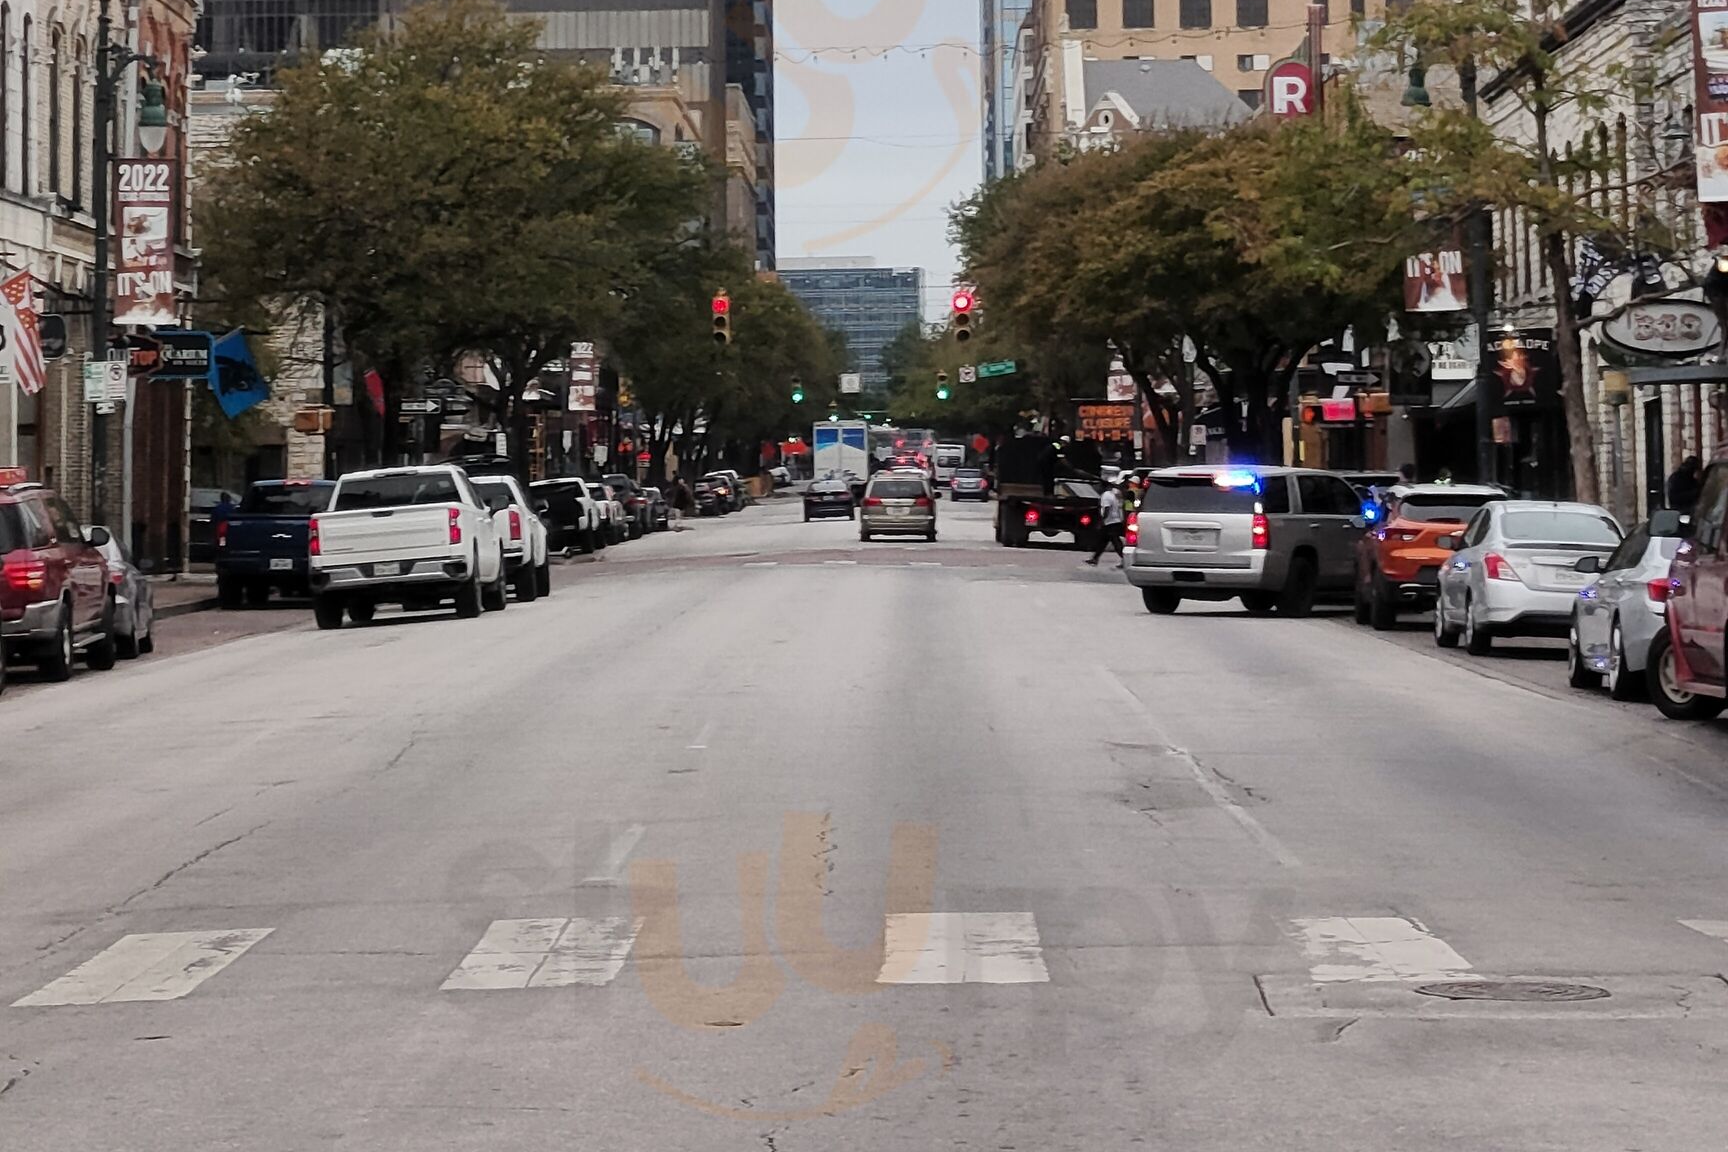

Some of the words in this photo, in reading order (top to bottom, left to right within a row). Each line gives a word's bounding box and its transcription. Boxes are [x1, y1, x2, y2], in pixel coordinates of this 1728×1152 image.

[1272, 76, 1308, 114] R
[118, 164, 170, 192] 2022
[1438, 250, 1463, 274] ON
[149, 270, 173, 294] ON
